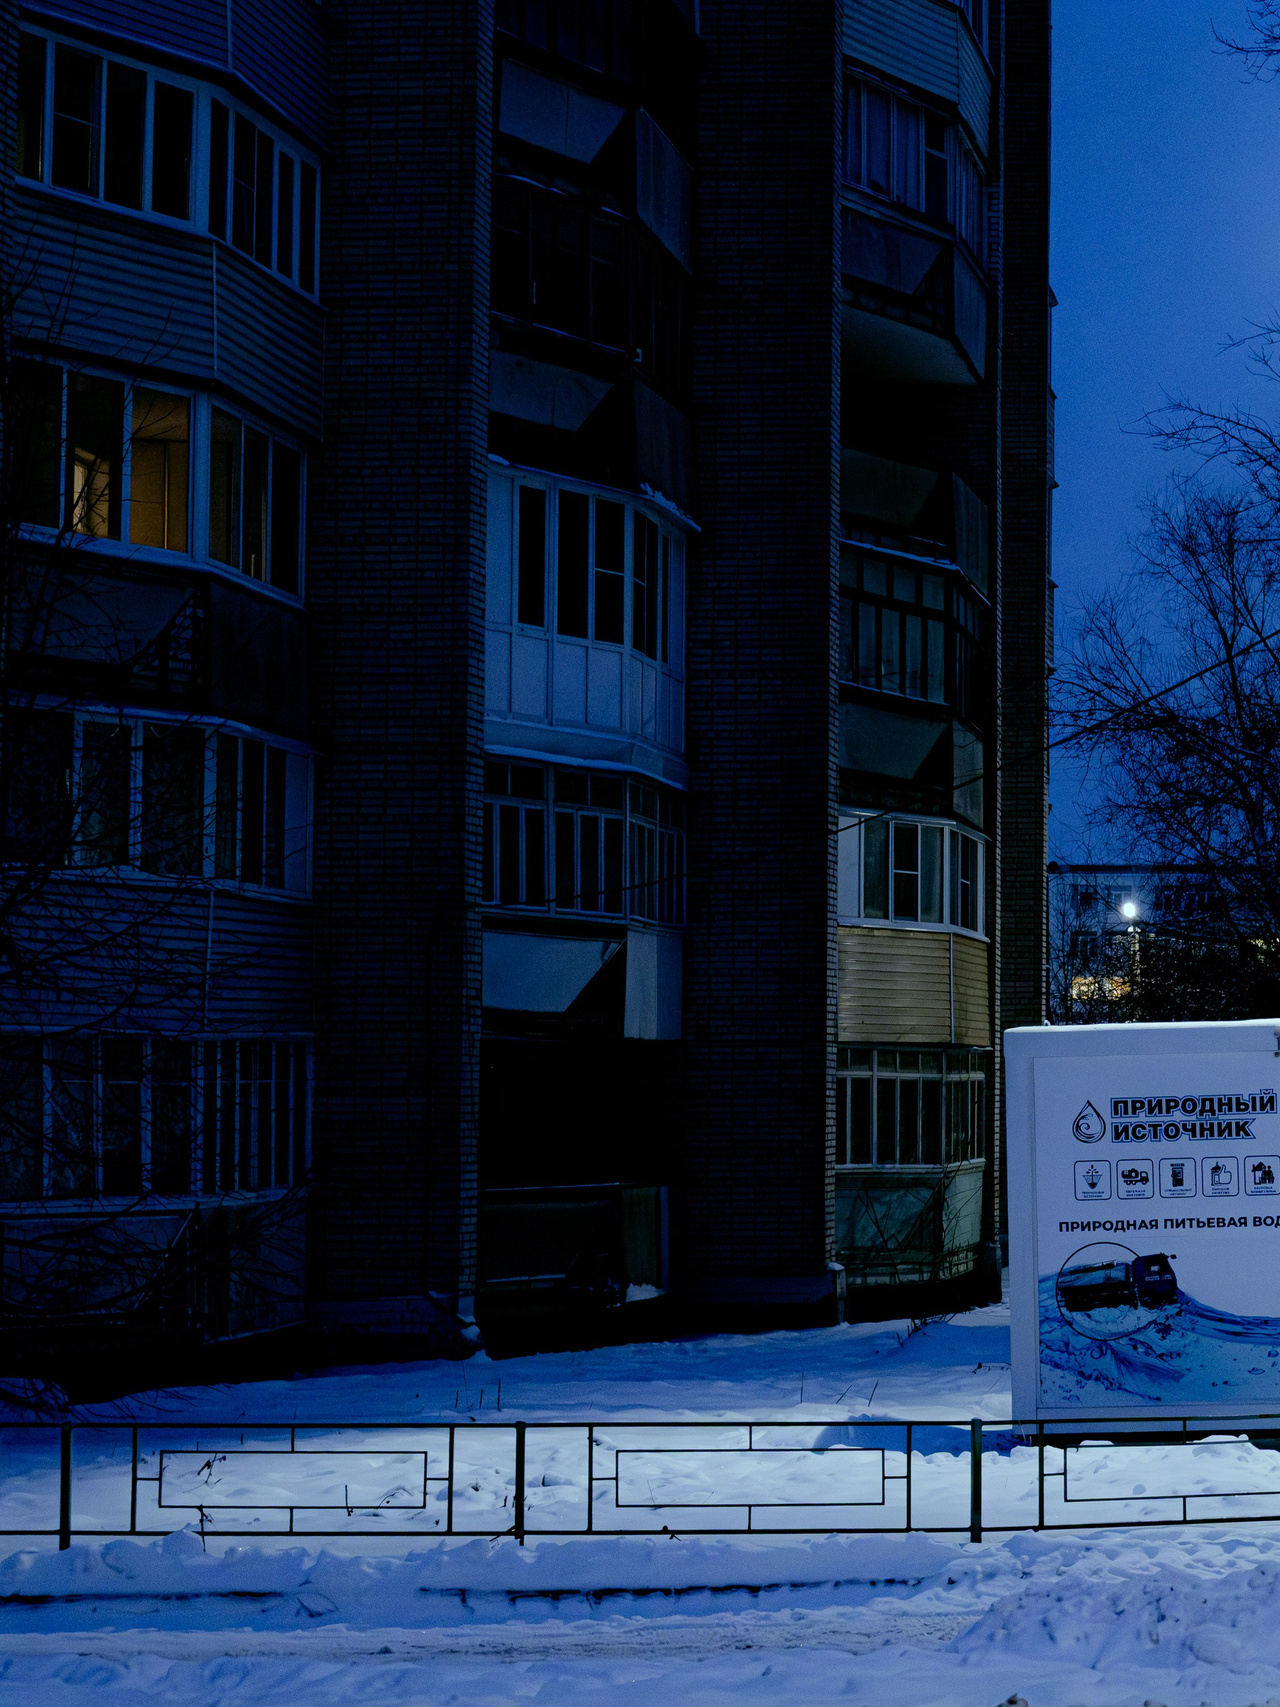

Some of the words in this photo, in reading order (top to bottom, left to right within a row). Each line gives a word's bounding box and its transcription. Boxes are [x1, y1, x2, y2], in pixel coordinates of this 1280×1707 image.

[1112, 1090, 1276, 1118] ПРИРОДНЫЙ
[1113, 1119, 1252, 1141] ИСТОЧНИК
[1059, 1219, 1158, 1233] ПРИРОДНАЯ
[1164, 1216, 1247, 1229] ПИТЬЕВАЯ
